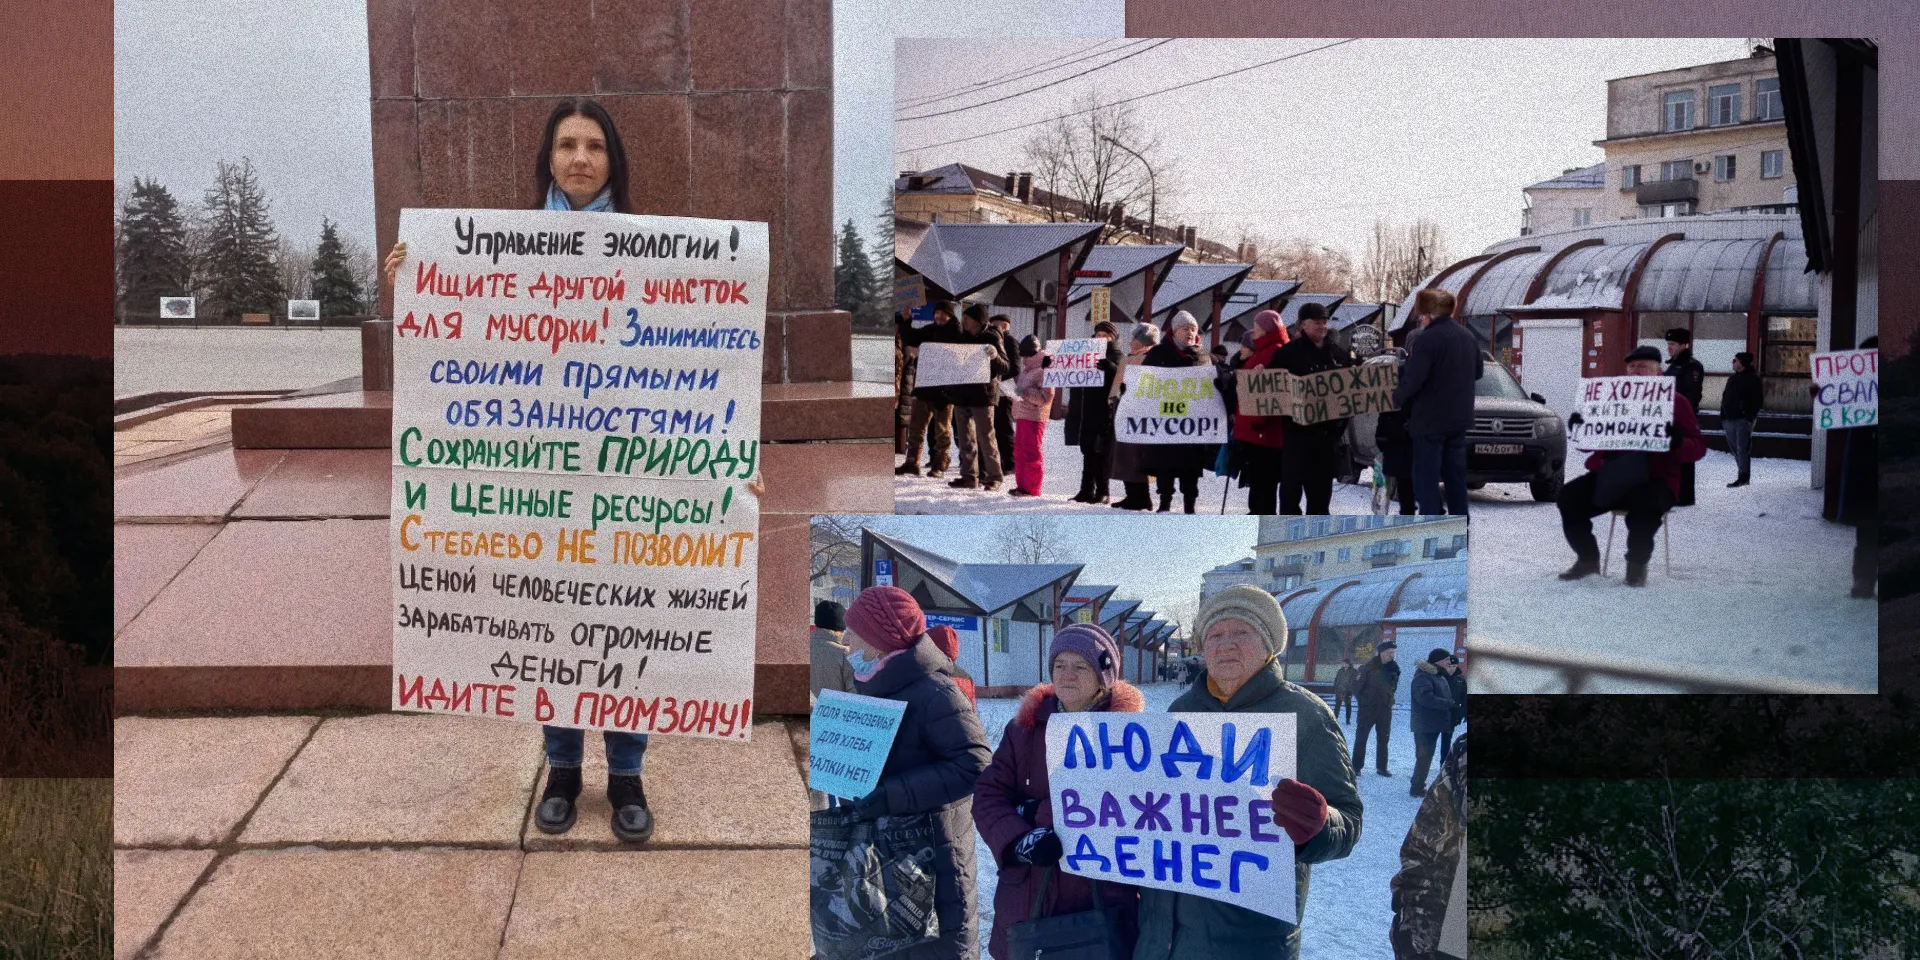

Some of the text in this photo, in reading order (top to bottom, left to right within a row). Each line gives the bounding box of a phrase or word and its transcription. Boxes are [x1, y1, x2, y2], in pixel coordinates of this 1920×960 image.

[455, 216, 586, 264] УПРАВЛЕНИЕ
[416, 261, 750, 307] ИЩИТЕ ДРУГОЙ УЧАСТОК
[396, 307, 761, 354] ДЛЯ МУСОРКИ! ЗАНИМАЙТЕСЬ
[430, 360, 719, 399] СВОИМИ ПРЯМЫМИ
[1045, 370, 1102, 386] МУСОРА
[1349, 363, 1400, 390] ЖИТЬ
[1585, 381, 1673, 402] НЕ ХОТИМ
[446, 399, 736, 434] ОБЯЗАННОСТЯМИ!
[1163, 402, 1186, 413] не
[1256, 398, 1282, 415] НА
[1589, 403, 1662, 417] ЖИТЬ НА
[1821, 408, 1833, 428] В
[399, 426, 759, 479] СОХРАНЯЙТЕ ПРИРОДУ
[404, 480, 733, 535] И ЦЕННЫЕ РЕСУРСЫ!
[400, 514, 754, 568] СТЕБАЕВО НЕ ПОЗВОЛИТ
[399, 563, 750, 611] ЦЕНОЙ ЧЕЛОВЕЧЕСКИХ ЖИЗНЕЙ
[398, 604, 713, 659] ЗАРАБАТЫВАТЬ ОГРОМНЫЕ
[399, 674, 752, 739] ИДИТЕ В ПРОМЗОНУ!
[816, 704, 895, 730] ПОЛЯ ЧЕРНОЗЕМЬЯ
[816, 730, 873, 752] ДЛЯ ХЛЕБА
[1063, 720, 1273, 787] ЛЮДИ
[844, 764, 871, 783] НЕТ!
[1061, 788, 1280, 843] ВАЖНЕЕ
[1066, 833, 1270, 894] ДЕНЕГ
